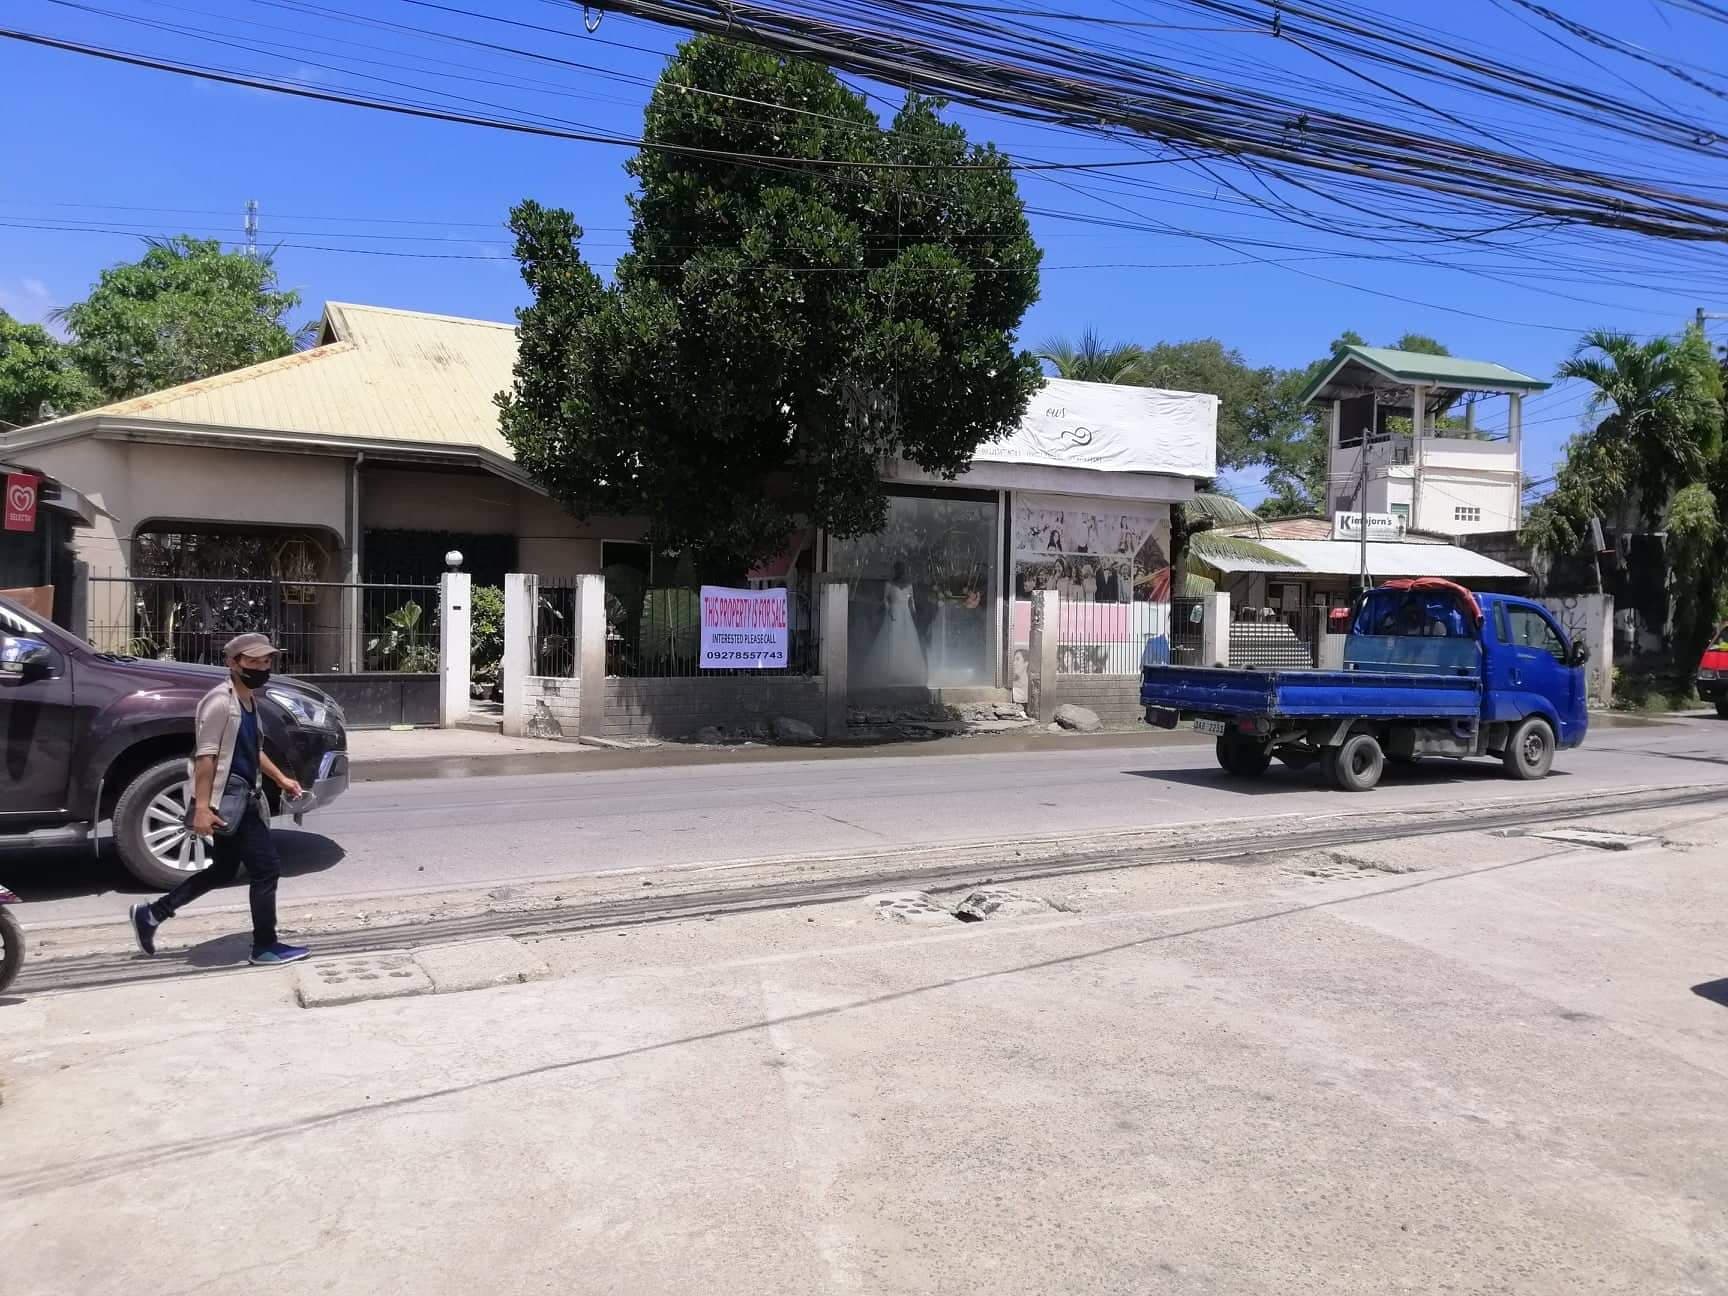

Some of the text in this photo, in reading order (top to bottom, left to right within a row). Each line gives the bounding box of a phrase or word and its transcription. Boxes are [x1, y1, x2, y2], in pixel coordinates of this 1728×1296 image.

[1340, 515, 1393, 530] Kimjorn's
[704, 596, 786, 628] THIS PROPERTY IS FOR SALE
[712, 633, 777, 644] INTERESTED PLEASE CALL
[706, 651, 783, 660] 09278557743
